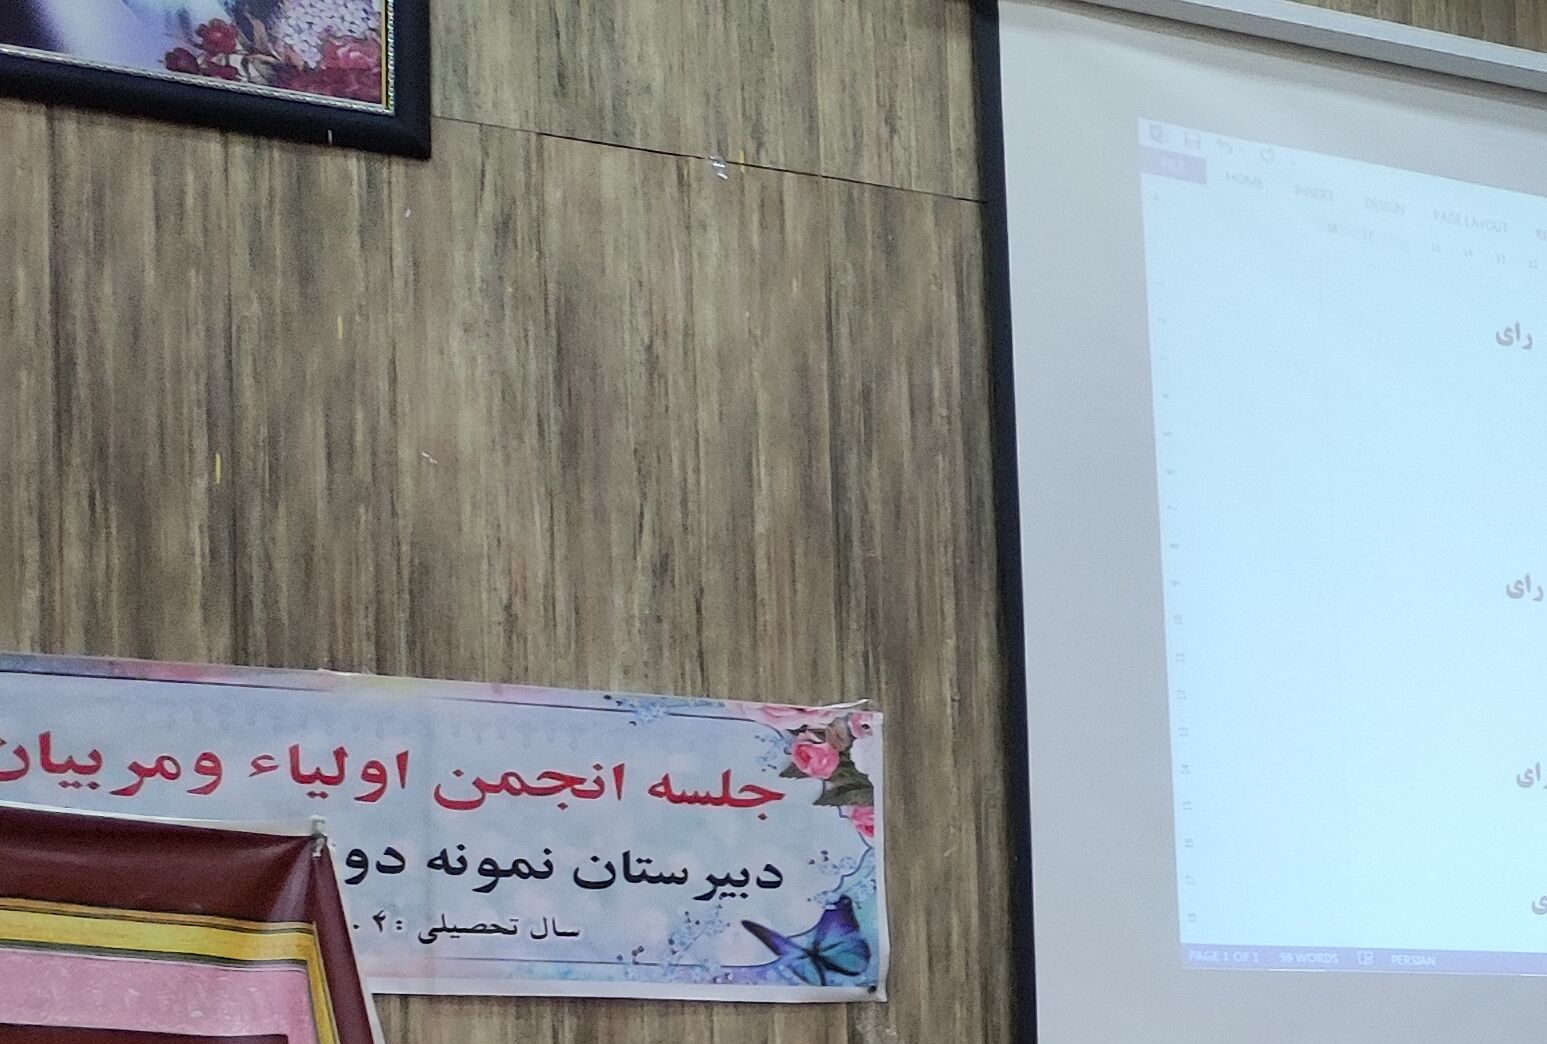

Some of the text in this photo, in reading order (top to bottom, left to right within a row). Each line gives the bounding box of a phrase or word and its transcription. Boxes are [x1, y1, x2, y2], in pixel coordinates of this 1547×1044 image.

[1294, 184, 1335, 202] INSERT
[1495, 320, 1533, 351] رای
[1505, 573, 1545, 603] رای
[249, 742, 410, 804] اولیاء
[433, 762, 626, 812] انجمن
[647, 768, 787, 822] جلسه
[344, 842, 784, 902] دبیرستان نمونه دو
[417, 911, 520, 946] تحصیلی
[530, 916, 580, 940] سال
[1189, 950, 1221, 962] PAGE
[1294, 952, 1339, 964] WORDS
[1391, 954, 1437, 967] PERSIAN
